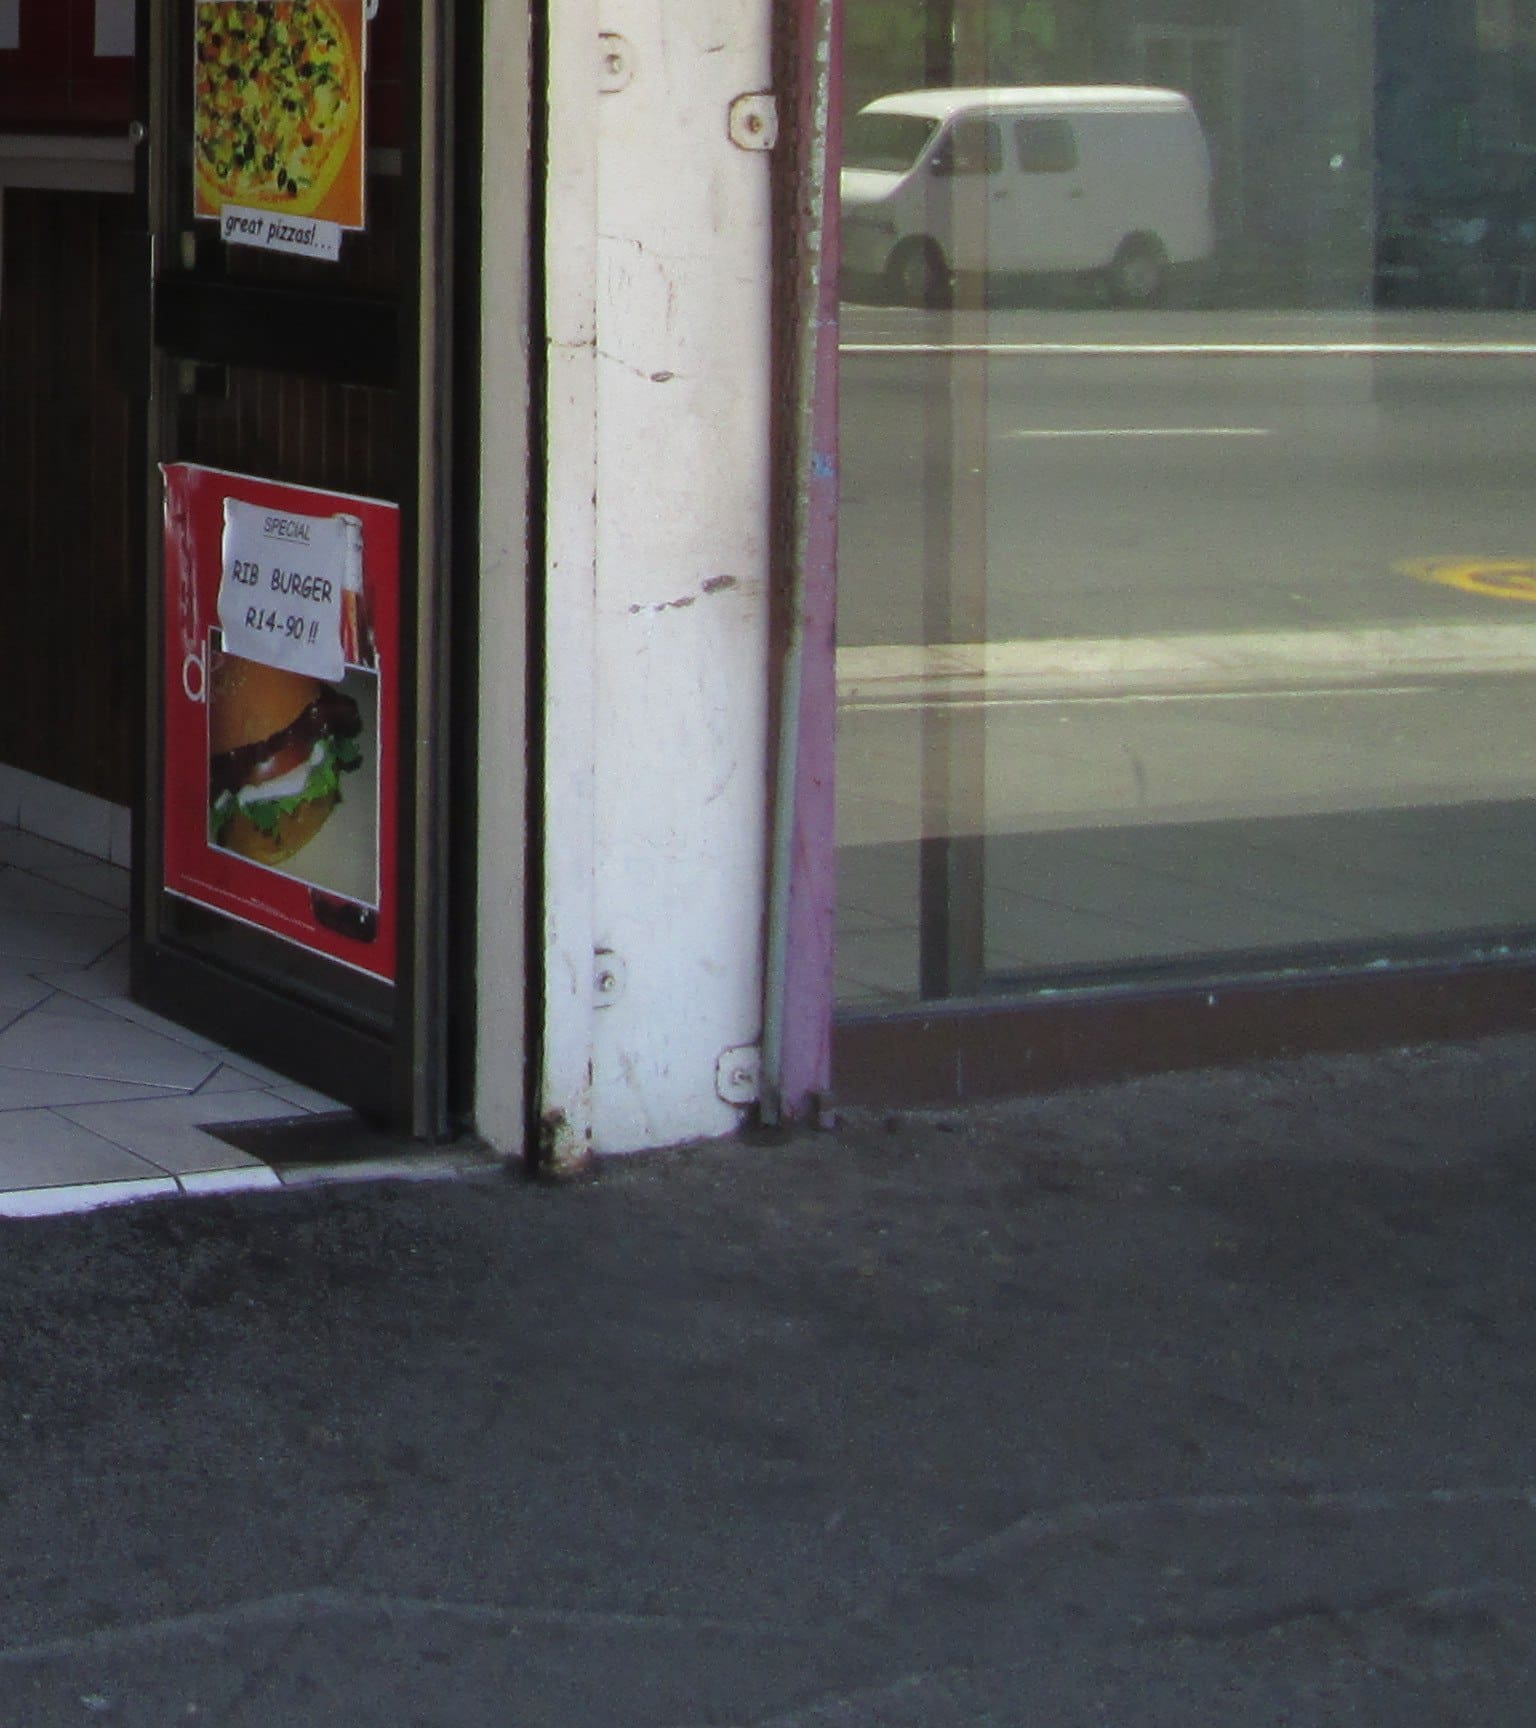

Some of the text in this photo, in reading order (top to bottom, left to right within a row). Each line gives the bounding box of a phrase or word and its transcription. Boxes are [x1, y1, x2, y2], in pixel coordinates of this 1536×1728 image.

[225, 215, 264, 237] great
[263, 515, 311, 541] SPECIAL
[232, 559, 333, 604] RIB BURGER
[245, 606, 305, 641] R14-90
